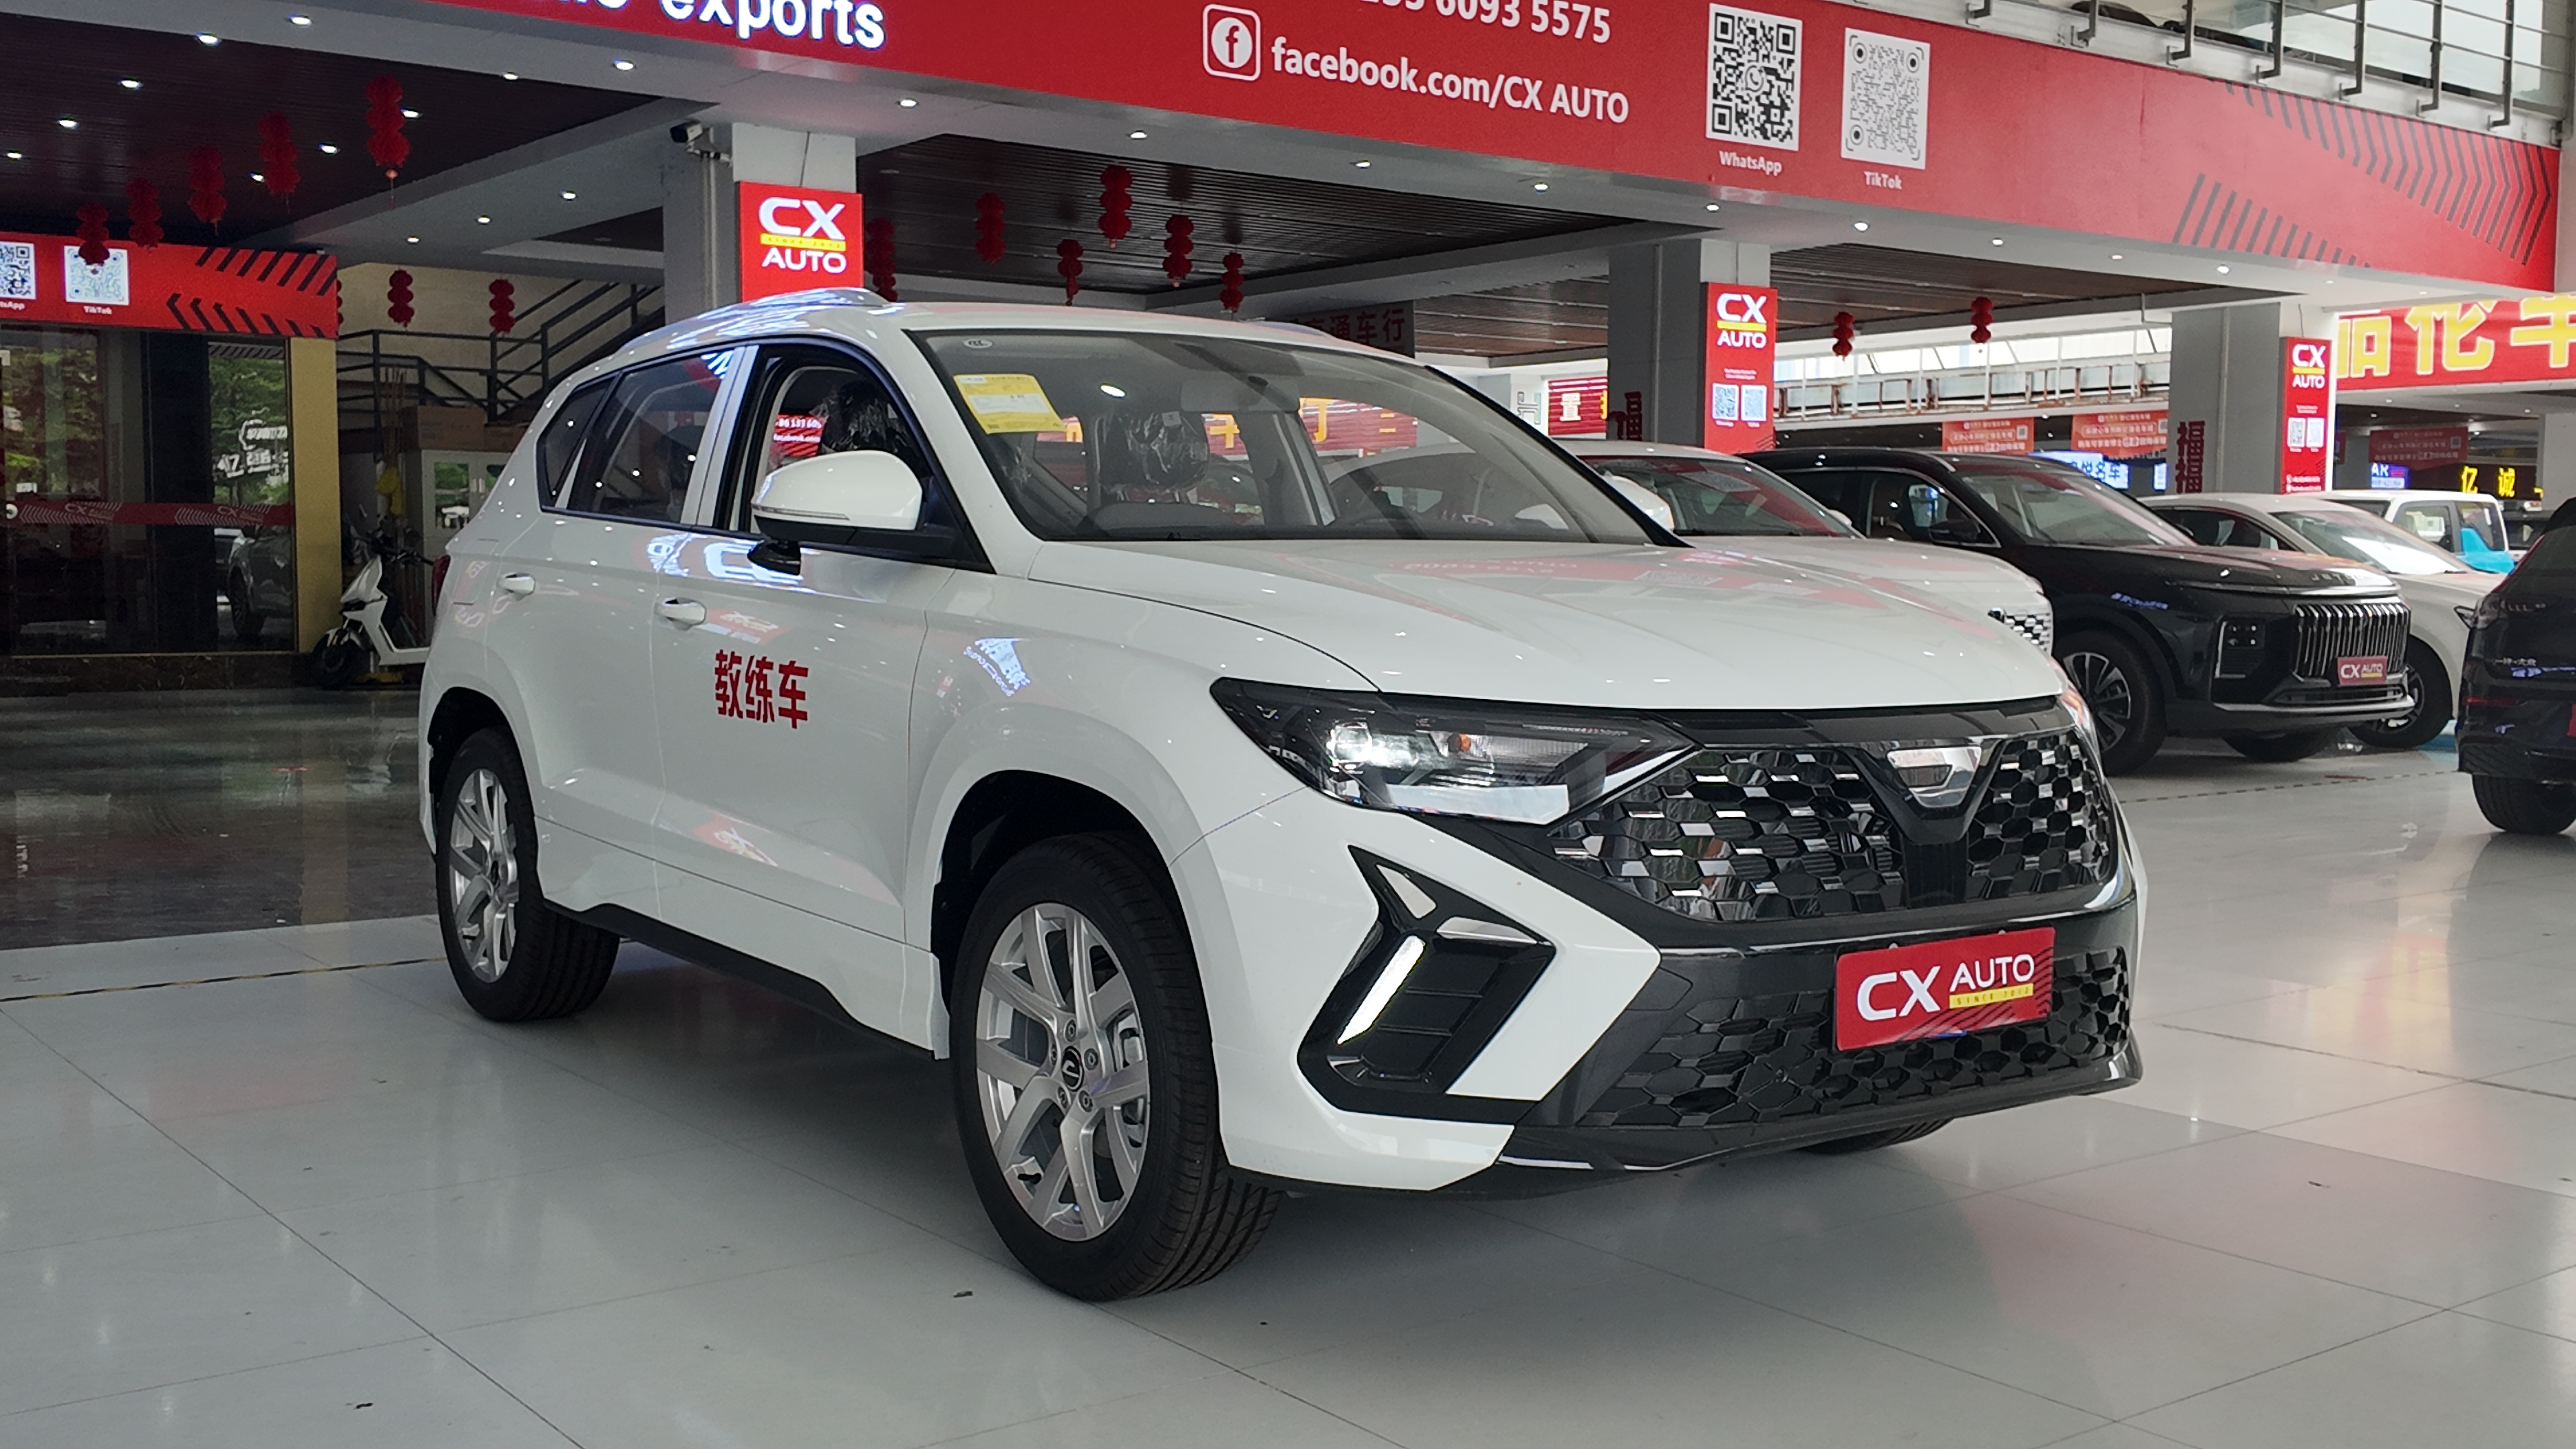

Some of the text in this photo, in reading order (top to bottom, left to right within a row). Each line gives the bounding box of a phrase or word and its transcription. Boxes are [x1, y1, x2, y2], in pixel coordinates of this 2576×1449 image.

[1530, 0, 1611, 44] 5575
[1271, 36, 1629, 123] facebook.com/CX AUTO
[1719, 150, 1782, 176] WhatsApp
[1864, 170, 1902, 191] TikTok
[759, 197, 846, 241] CX
[761, 247, 847, 274] AUTO
[83, 305, 113, 315] TikTok
[1717, 292, 1766, 323] CX
[1717, 331, 1767, 349] AUTO
[2292, 343, 2326, 368] CX
[2292, 374, 2326, 389] AUTO
[2341, 663, 2361, 679] CX
[2362, 663, 2383, 673] AUTO
[714, 649, 810, 730] 教练车
[1857, 953, 2035, 1021] CX AUTO
[1956, 993, 1994, 1005] SINCE
